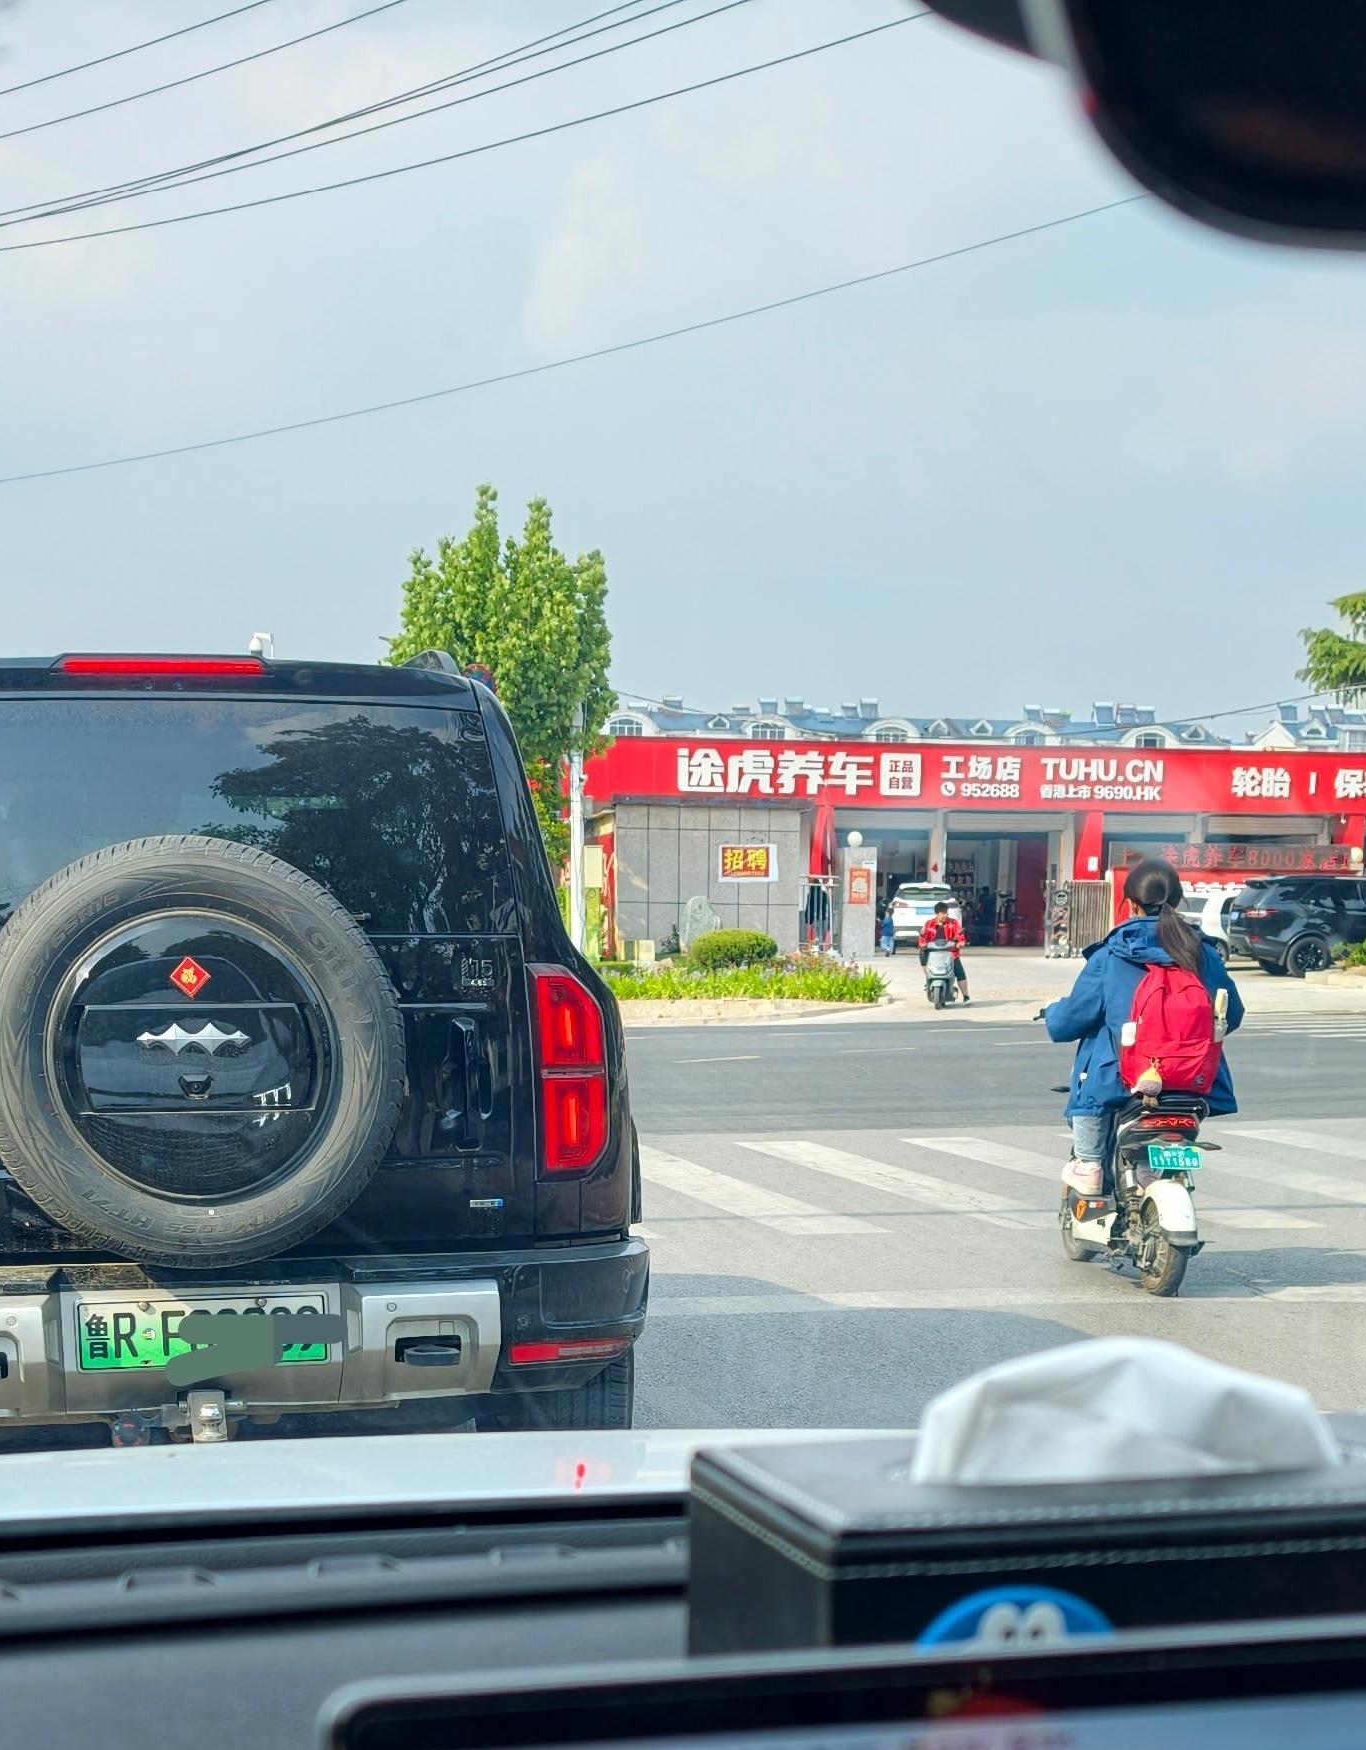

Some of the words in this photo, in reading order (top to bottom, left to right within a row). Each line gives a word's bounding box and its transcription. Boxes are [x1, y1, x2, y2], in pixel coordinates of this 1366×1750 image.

[677, 747, 875, 795] 途虎养车
[889, 759, 914, 773] 正品
[941, 755, 1021, 781] 工场店
[1040, 757, 1164, 782] TUHU.CN
[889, 776, 914, 790] 自营
[960, 782, 1020, 798] 952688
[1040, 784, 1091, 799] 香港上市
[1093, 785, 1162, 801] 9690.HK
[1231, 767, 1291, 798] 轮胎
[724, 848, 768, 871] 招聘
